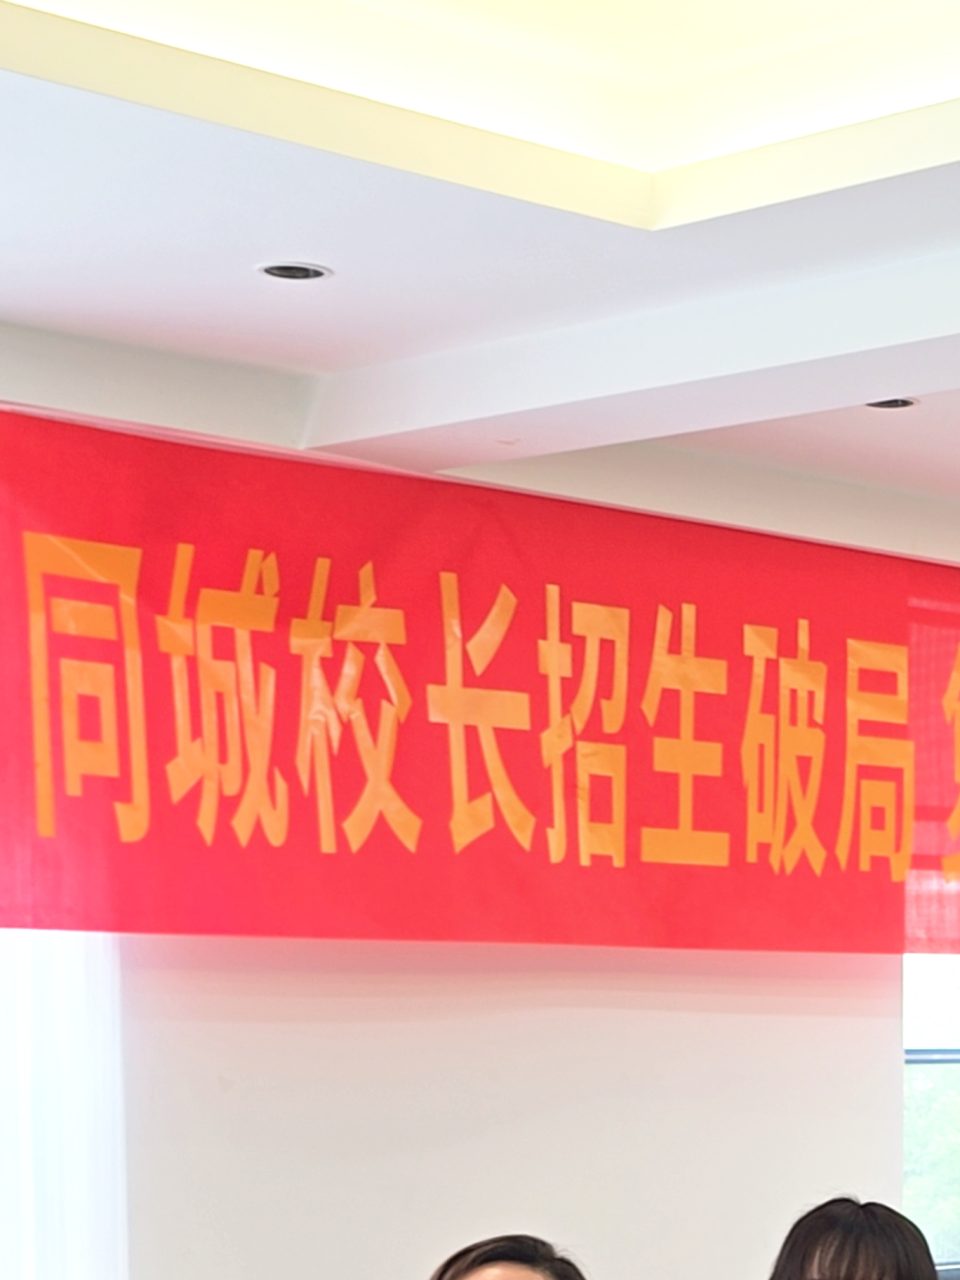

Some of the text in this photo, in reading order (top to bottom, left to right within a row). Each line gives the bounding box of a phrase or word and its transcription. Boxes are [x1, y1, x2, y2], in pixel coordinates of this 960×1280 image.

[22, 531, 915, 883] 同城校长招生破局
